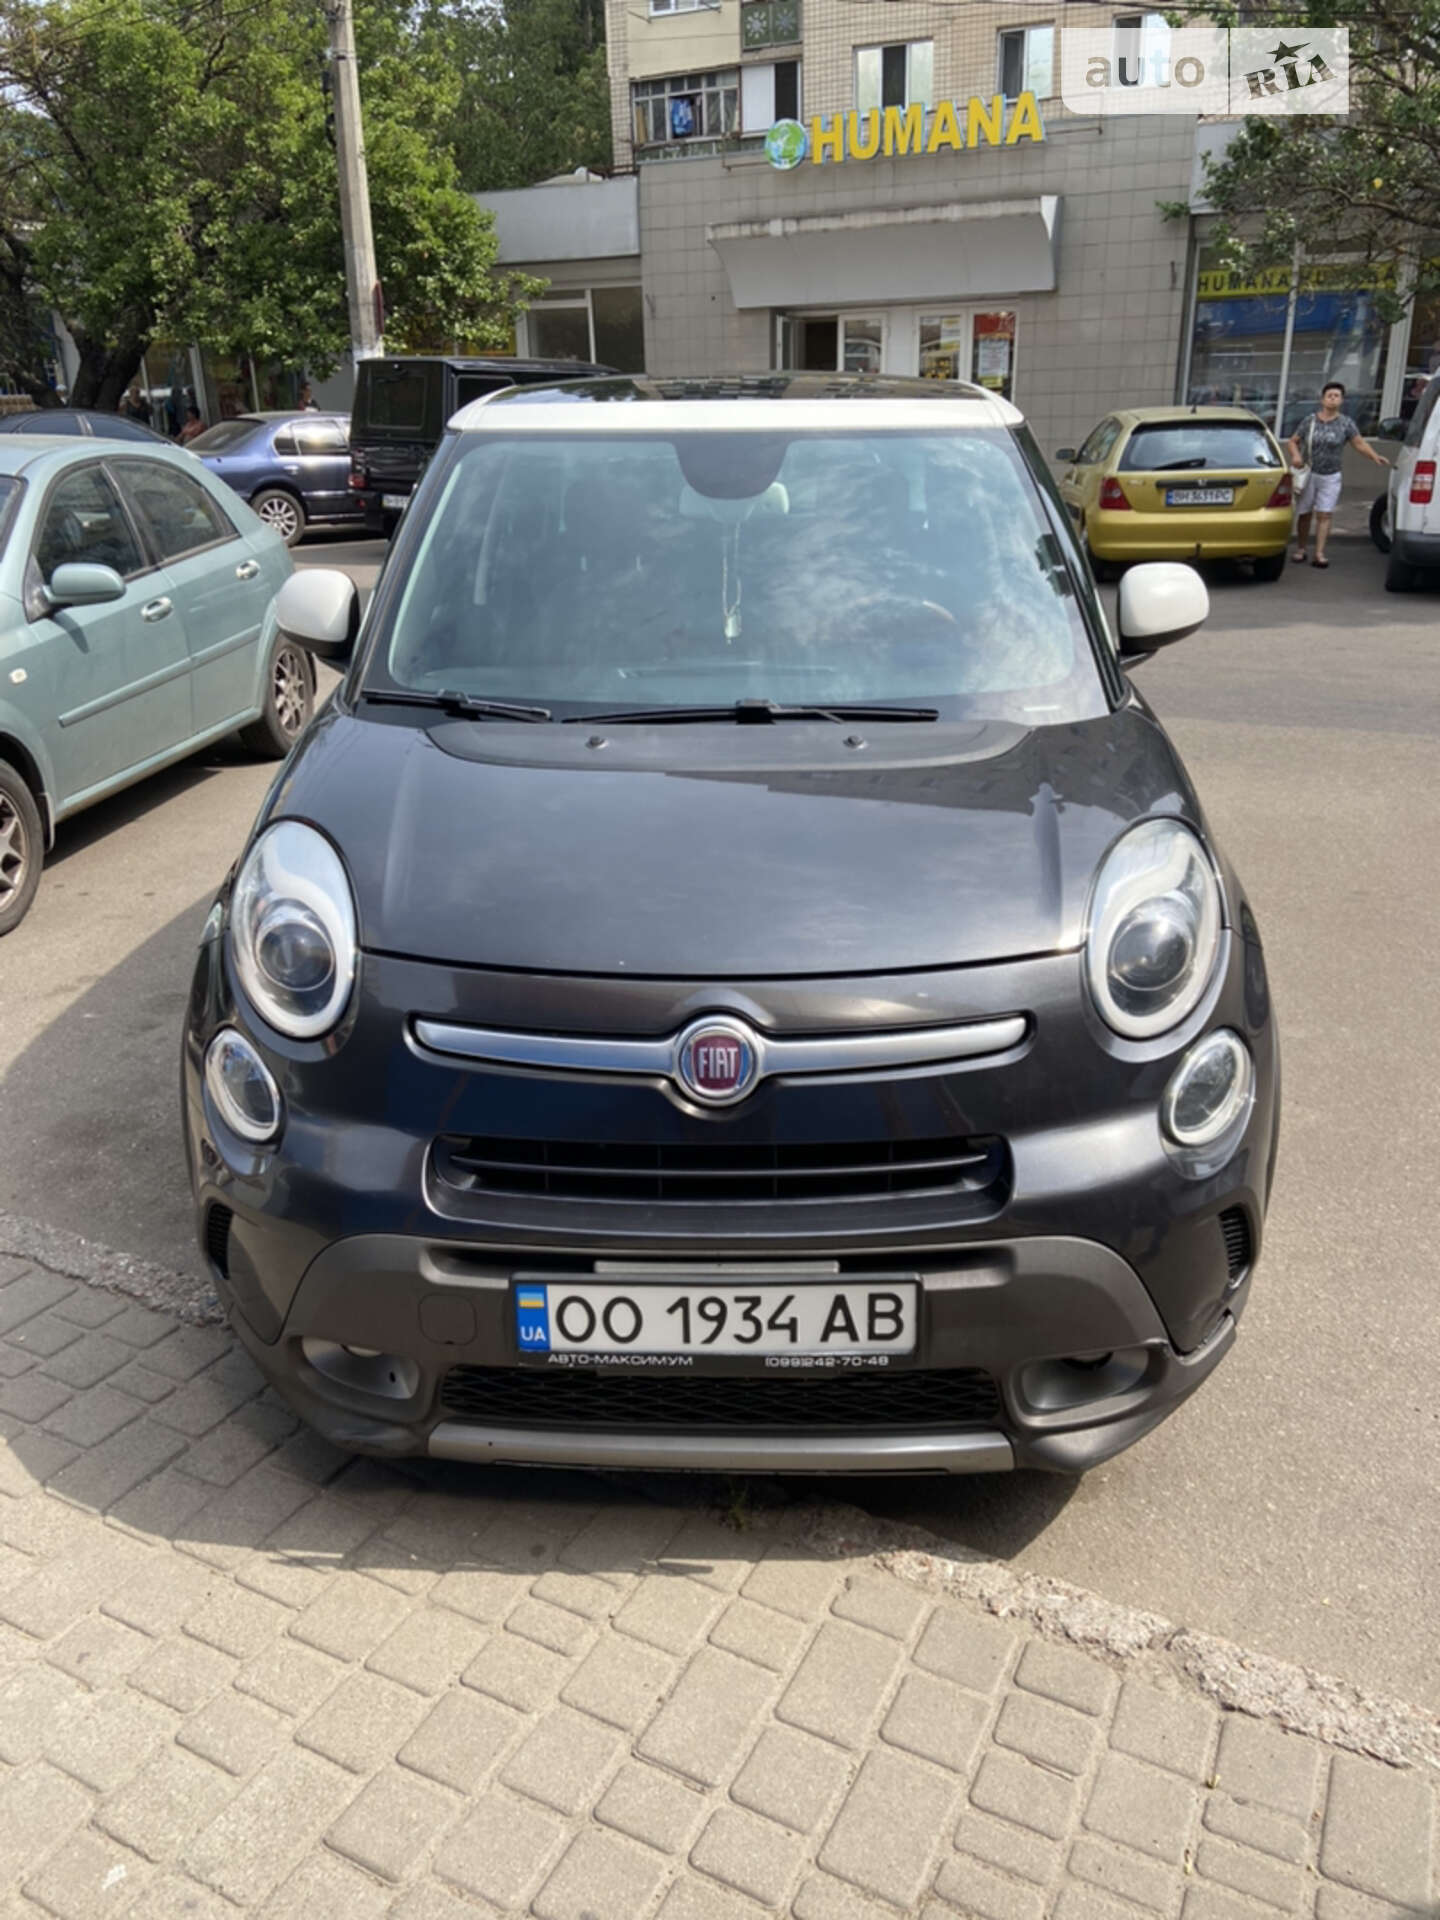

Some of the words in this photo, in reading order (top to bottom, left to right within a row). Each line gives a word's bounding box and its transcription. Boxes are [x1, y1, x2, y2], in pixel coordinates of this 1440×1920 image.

[811, 91, 1046, 165] HUMANA
[1199, 272, 1289, 292] HUMANA
[698, 1047, 738, 1079] FIAT
[521, 1326, 546, 1342] UA
[556, 1295, 643, 1344] OO
[666, 1295, 800, 1344] 1934
[819, 1293, 904, 1343] AB
[548, 1354, 693, 1367] АВТО-МАКСИМУМ
